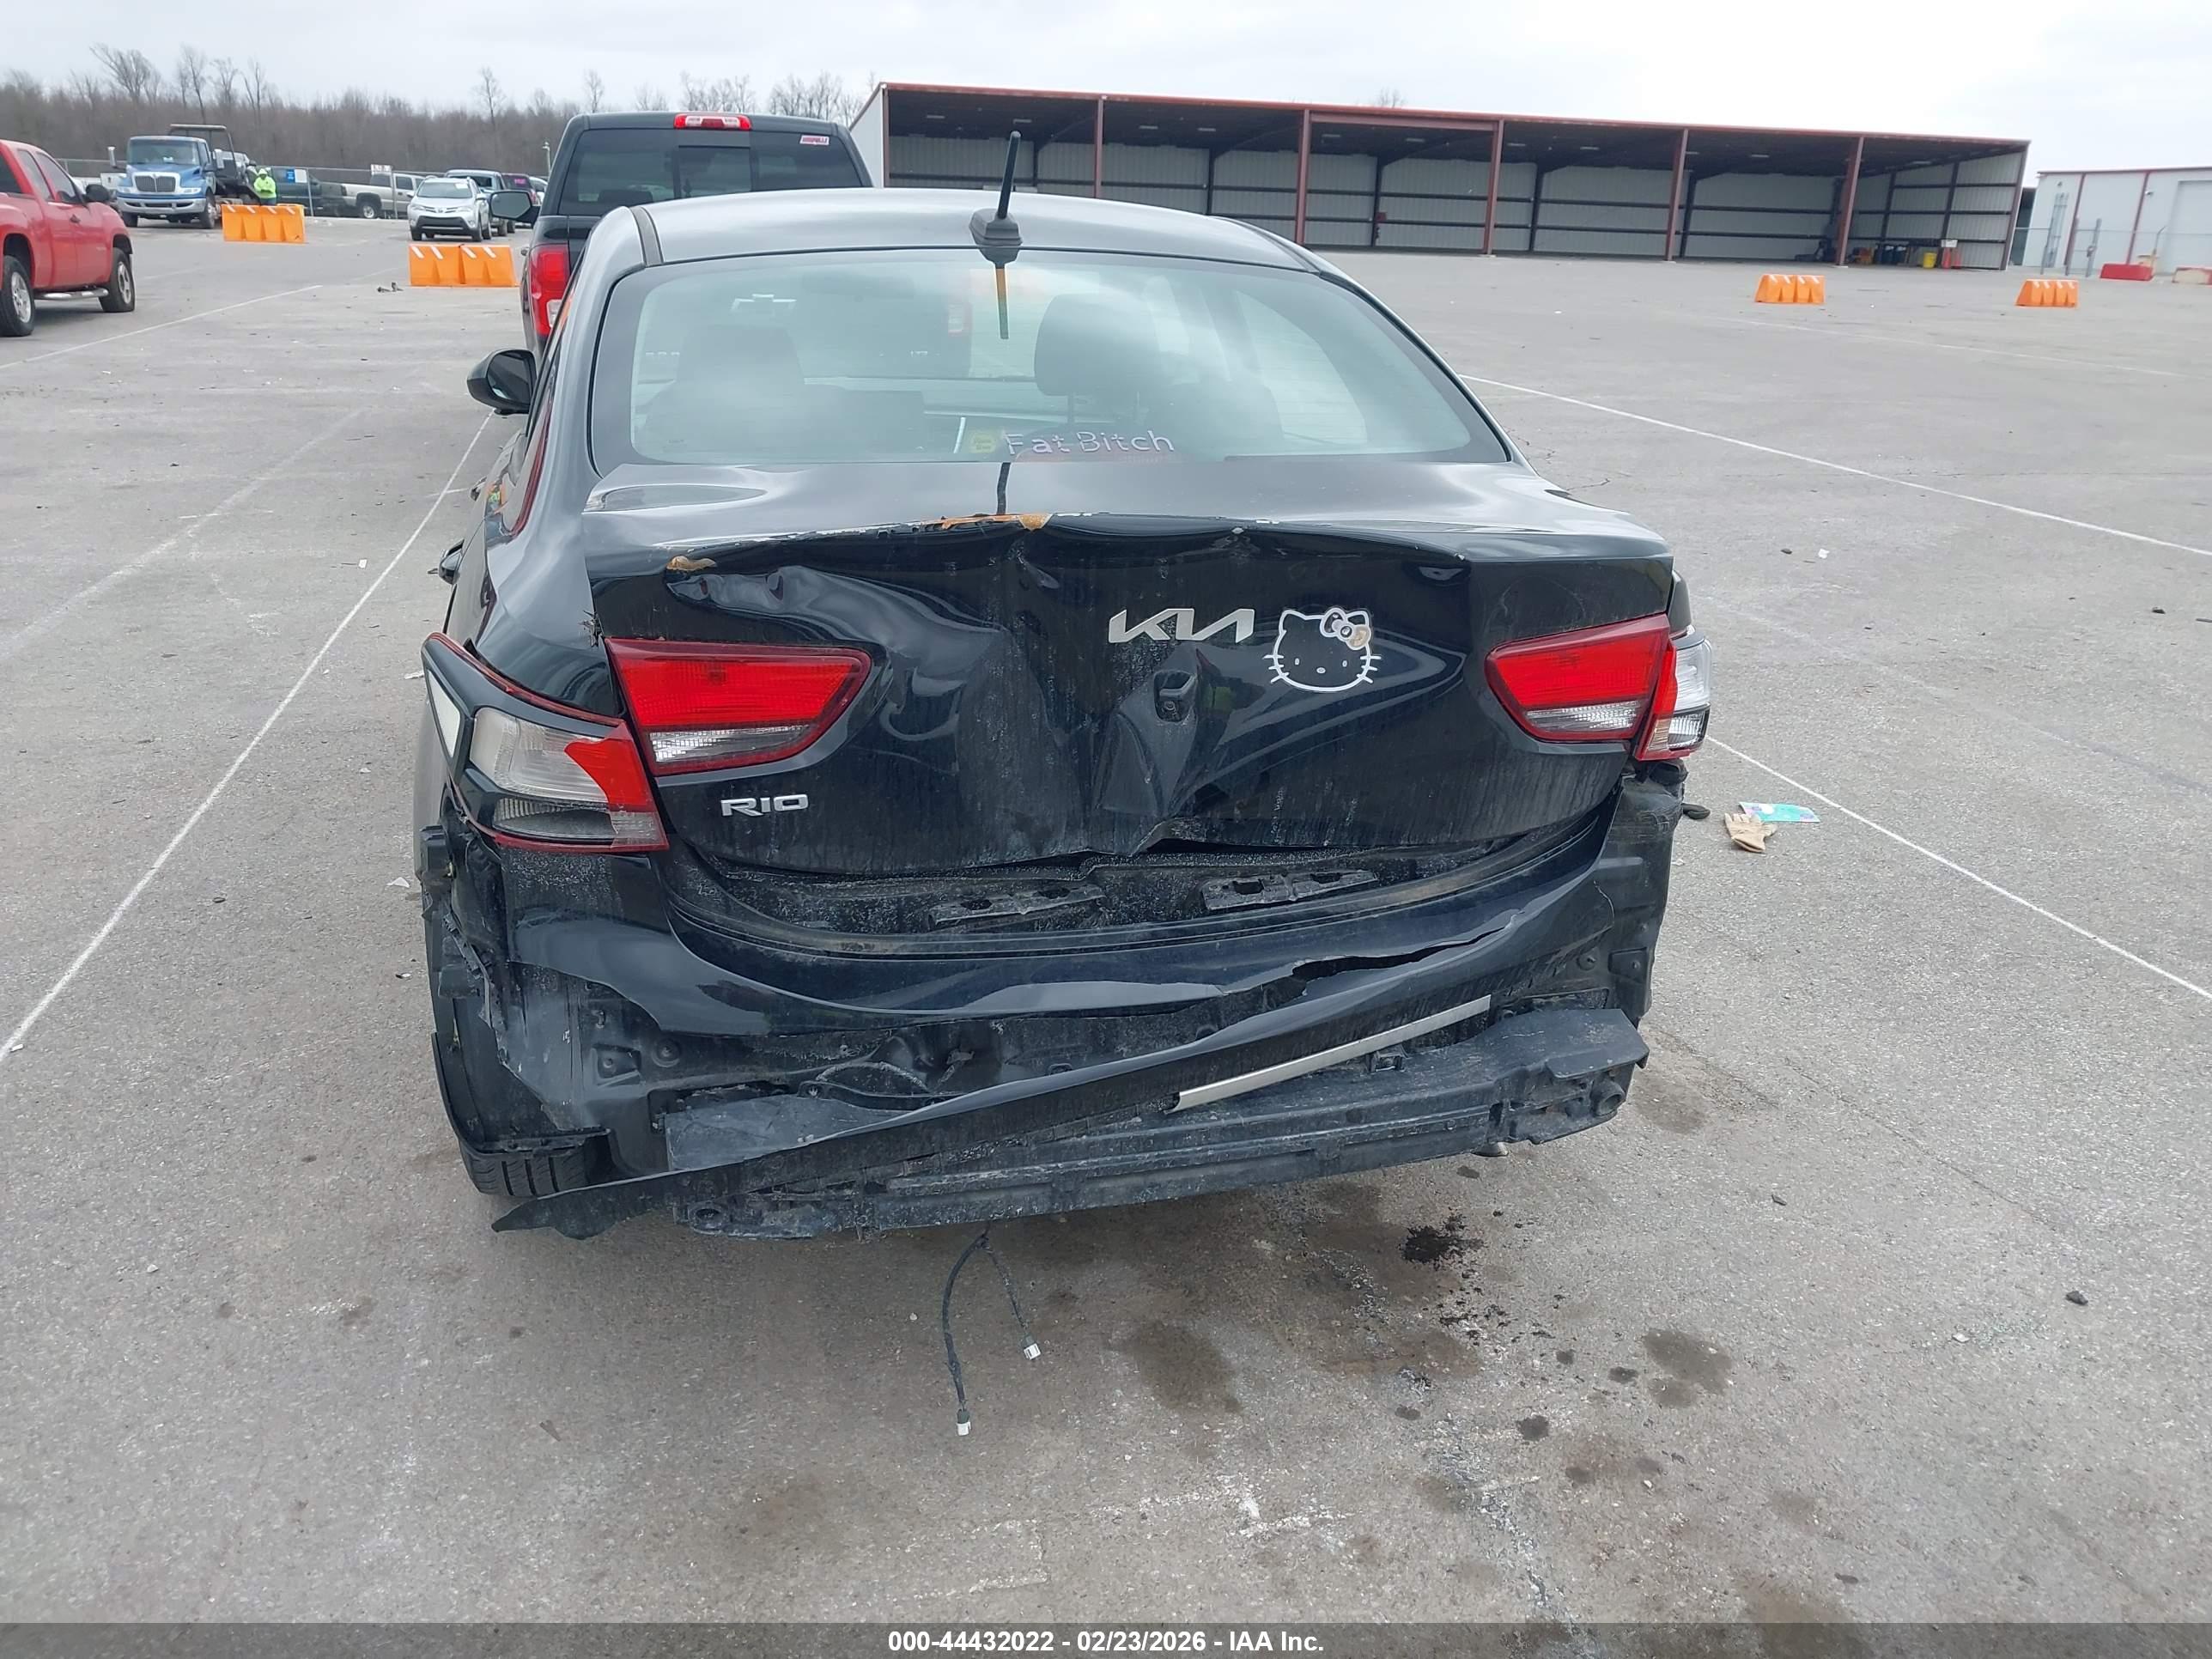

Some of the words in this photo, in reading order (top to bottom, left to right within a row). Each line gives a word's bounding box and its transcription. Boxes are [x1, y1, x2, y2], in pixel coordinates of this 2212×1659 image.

[1003, 434, 1070, 455] Fat
[1076, 430, 1176, 453] Bitch
[1108, 608, 1255, 643] KIA
[720, 793, 810, 817] RIO
